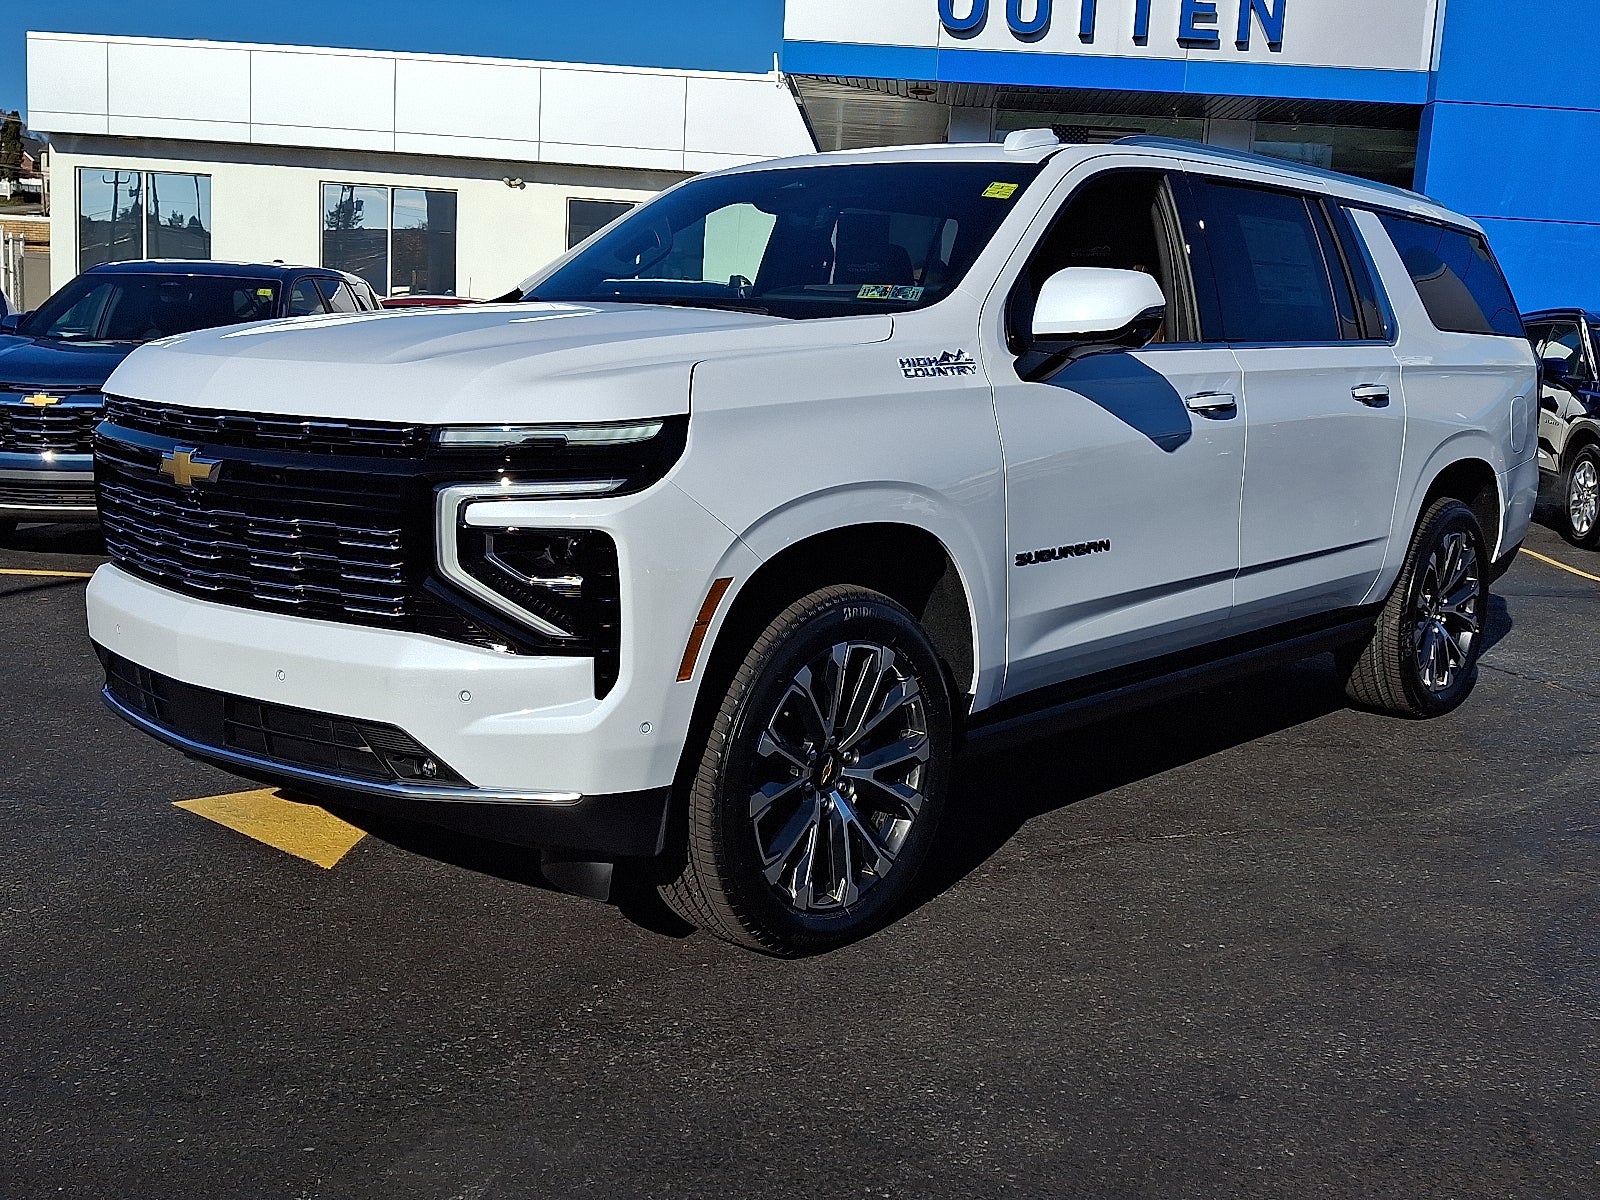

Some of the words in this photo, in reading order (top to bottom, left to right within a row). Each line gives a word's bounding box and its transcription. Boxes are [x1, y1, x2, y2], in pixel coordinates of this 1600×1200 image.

[898, 357, 941, 368] HIGH
[902, 366, 976, 378] COUNTRY
[1014, 538, 1110, 567] SUBURBAN
